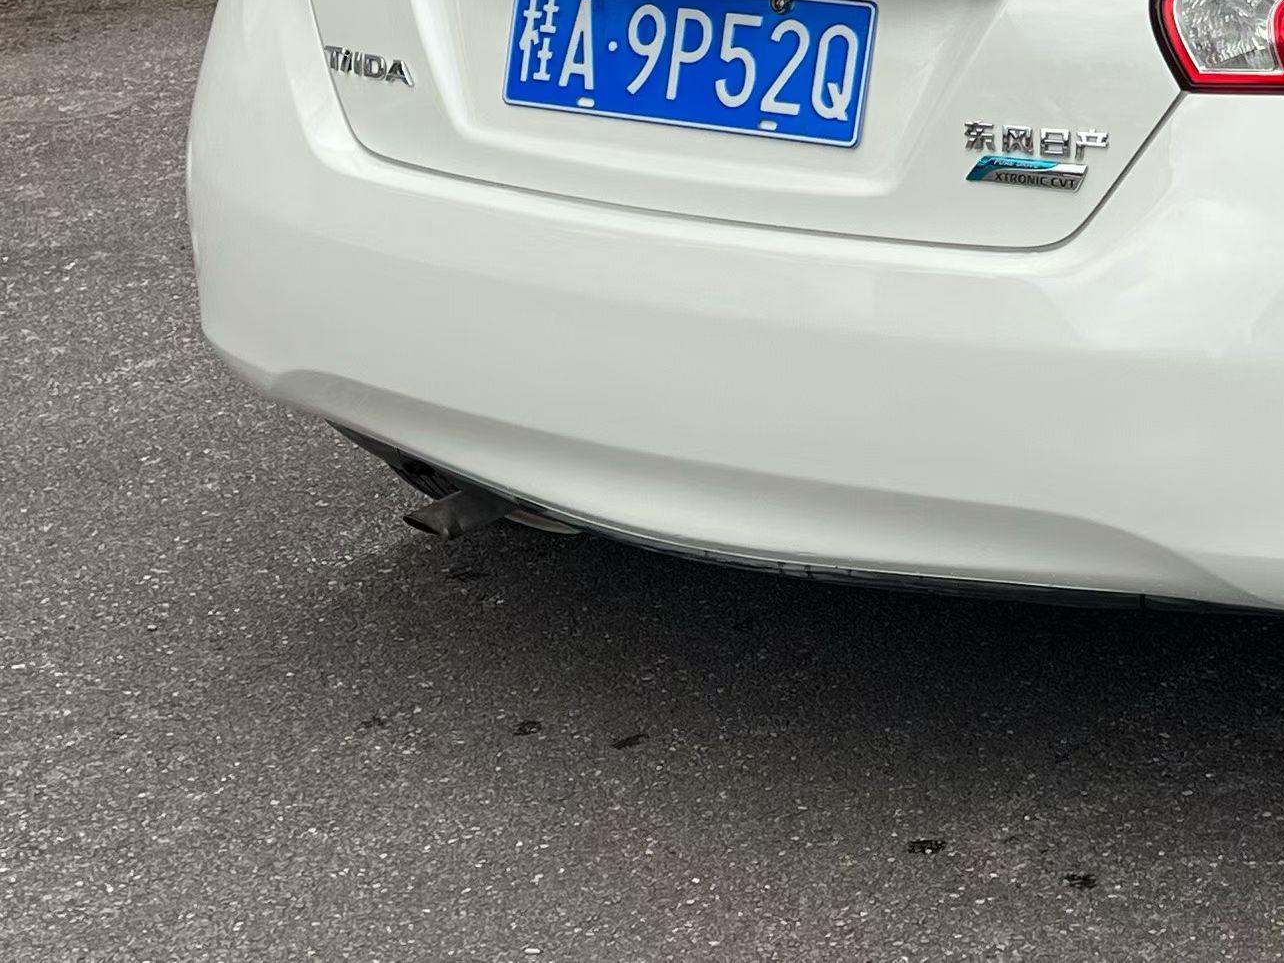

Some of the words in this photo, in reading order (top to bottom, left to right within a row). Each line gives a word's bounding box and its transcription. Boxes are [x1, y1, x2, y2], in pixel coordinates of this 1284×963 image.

[964, 120, 1109, 161] 东风日产
[994, 172, 1048, 186] XTRONIC
[1051, 177, 1076, 188] CVT
